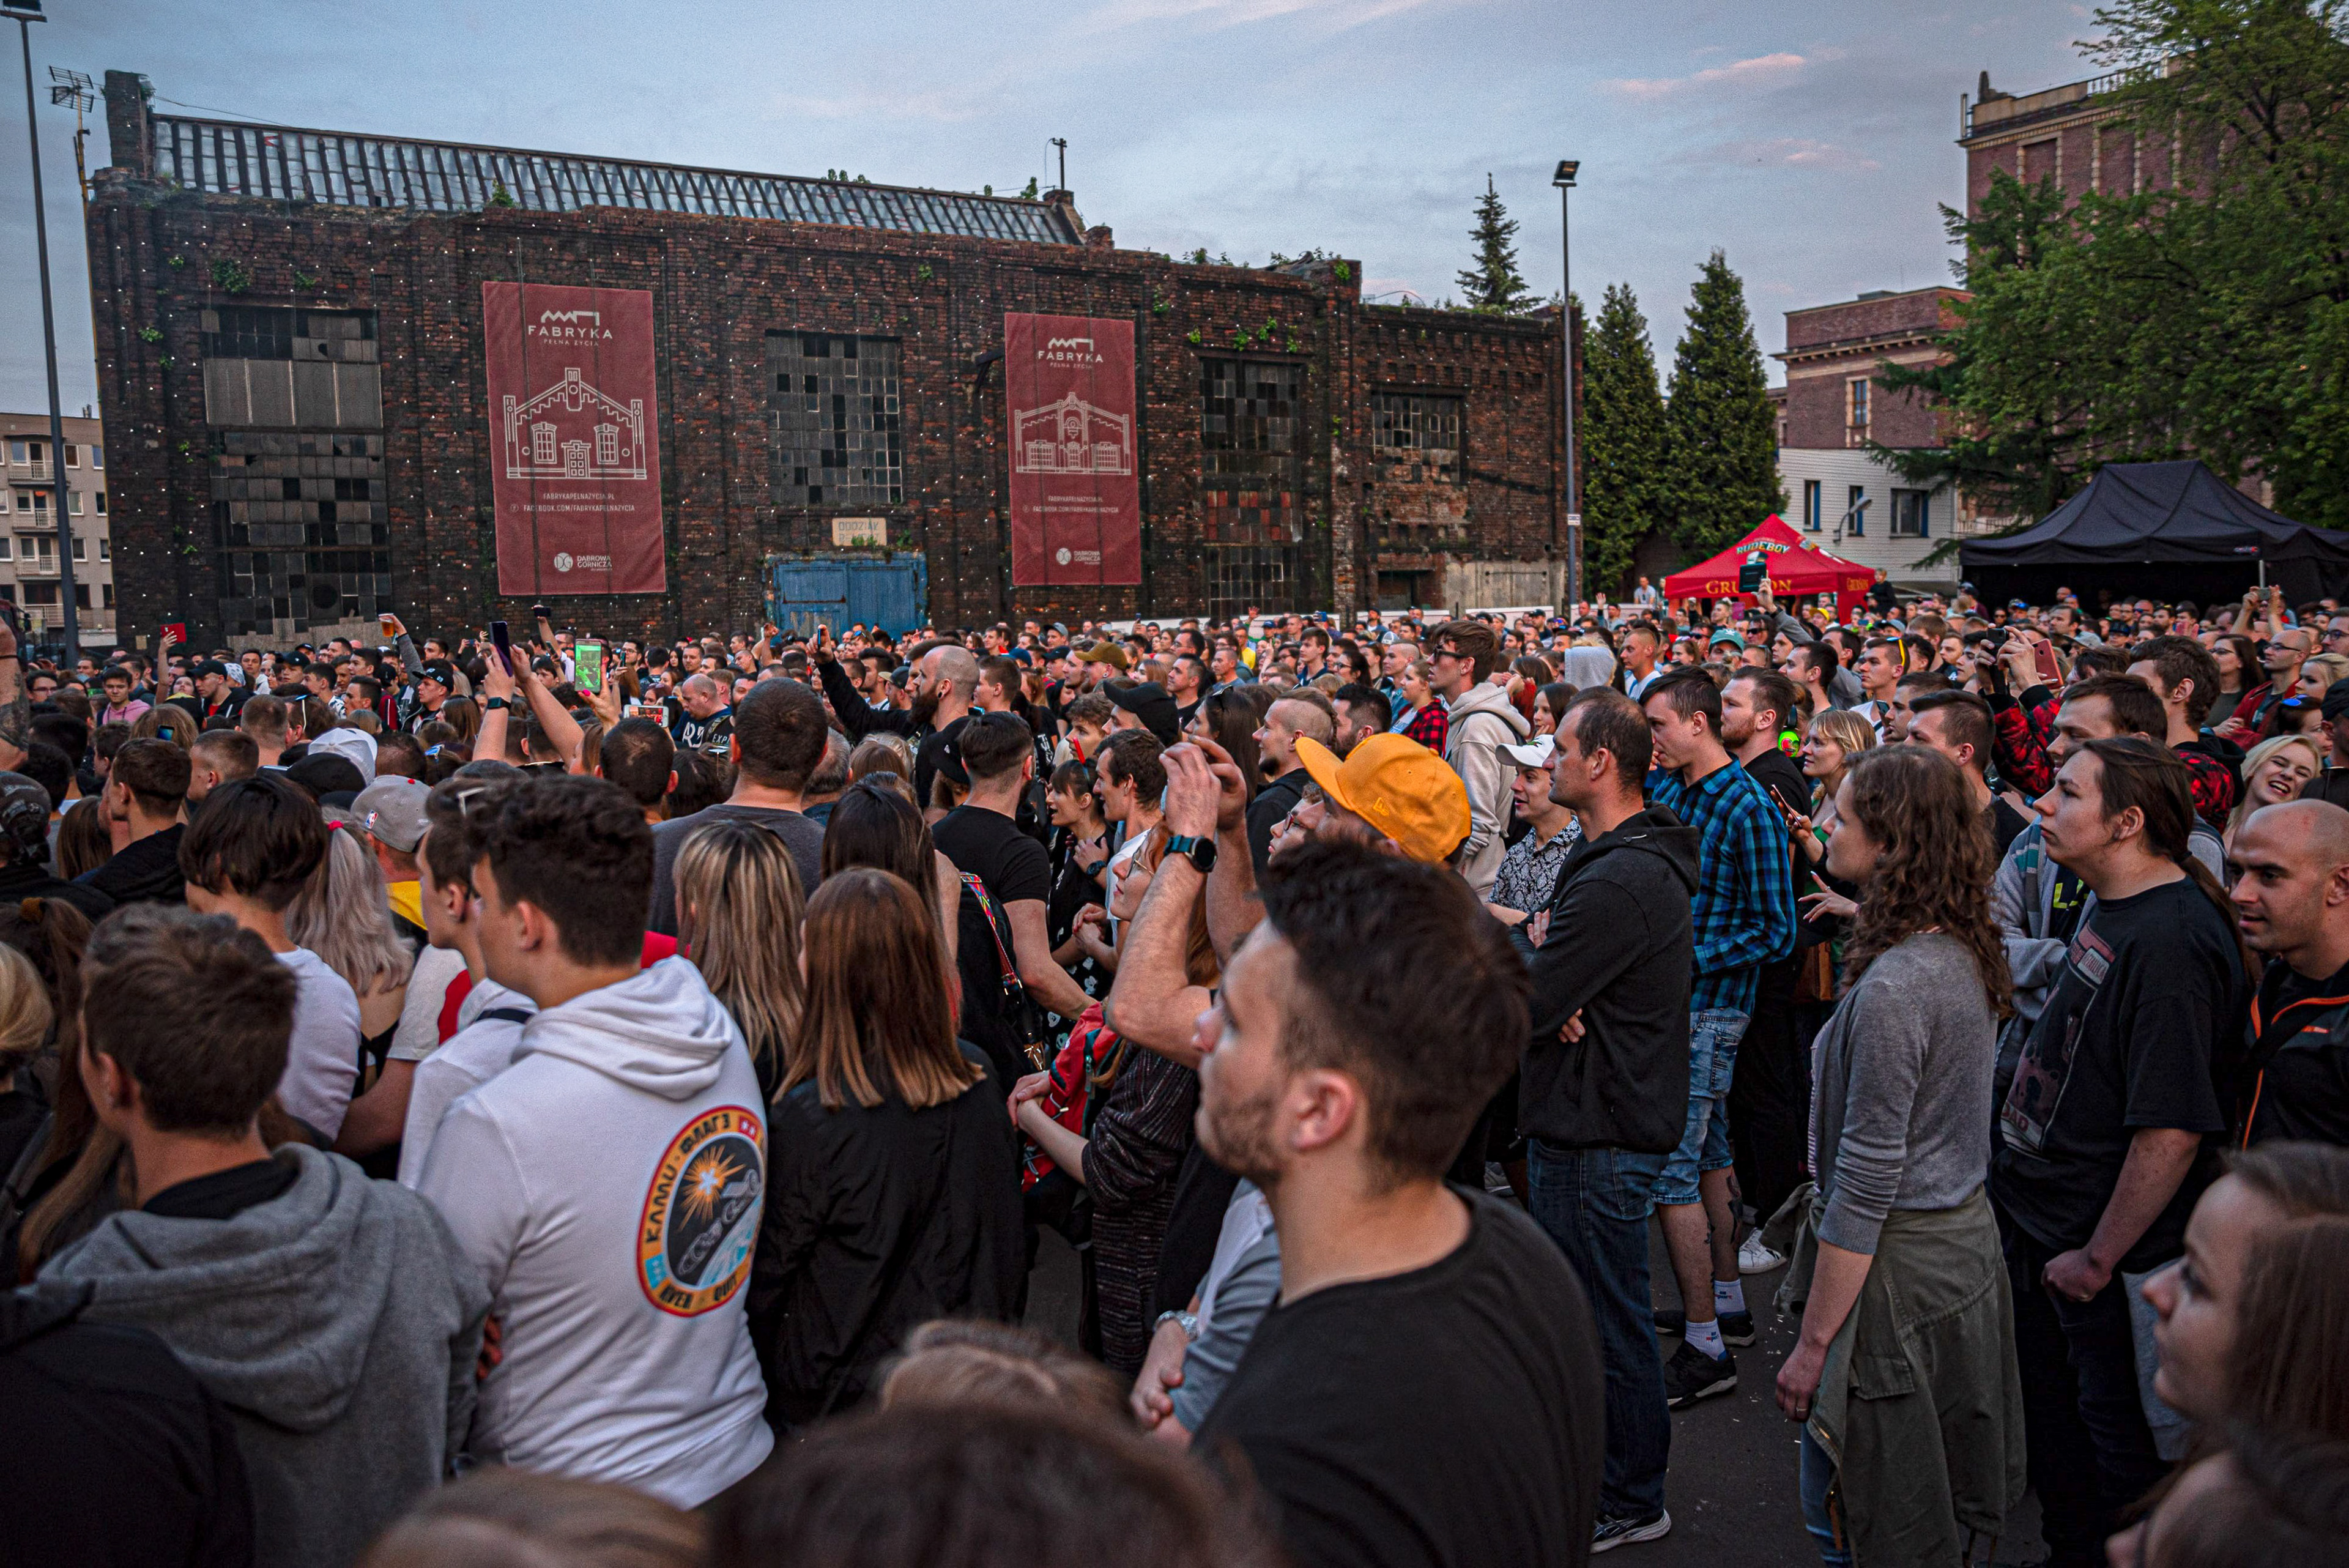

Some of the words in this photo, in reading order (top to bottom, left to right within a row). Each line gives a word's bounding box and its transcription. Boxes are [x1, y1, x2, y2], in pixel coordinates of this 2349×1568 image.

[528, 325, 613, 339] FABRYKA
[1038, 351, 1104, 363] FABRYKA
[1737, 541, 1791, 554] RUDEBOY
[1705, 579, 1792, 595] GRUON
